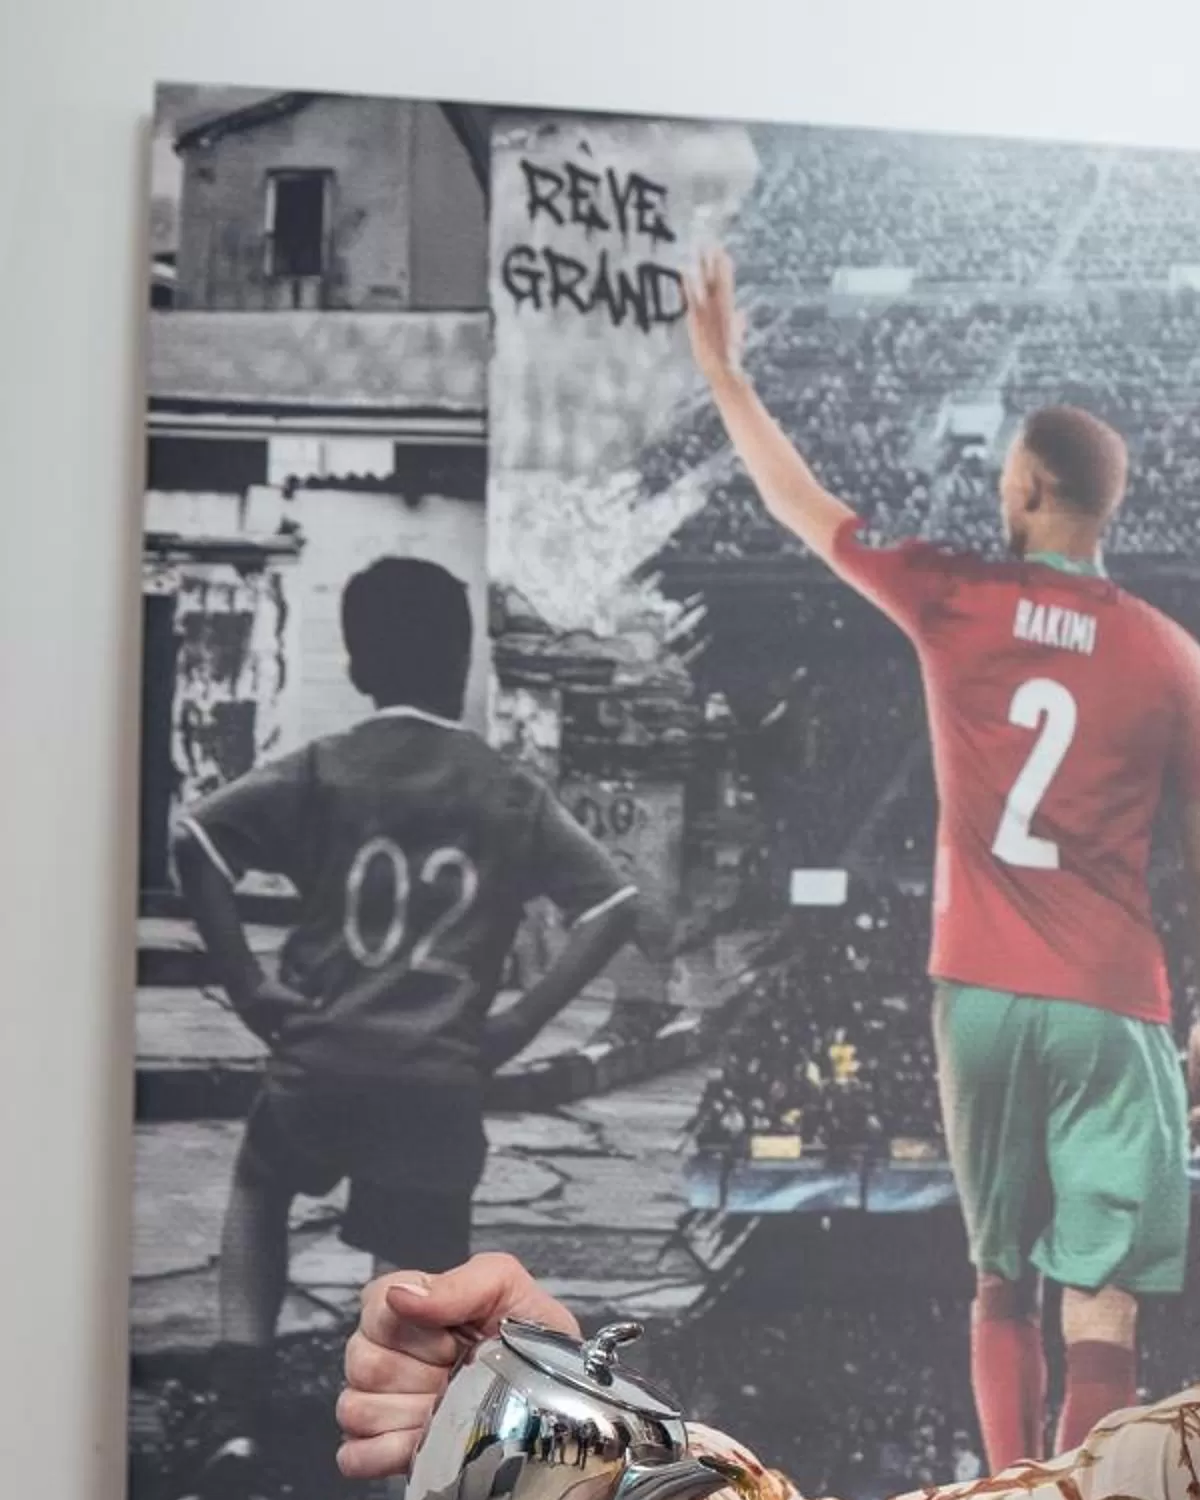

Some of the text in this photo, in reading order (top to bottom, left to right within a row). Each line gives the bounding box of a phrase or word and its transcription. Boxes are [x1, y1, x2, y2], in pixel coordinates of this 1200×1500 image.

[502, 244, 689, 334] GRAND
[991, 677, 1078, 870] 2
[343, 835, 479, 972] 02
